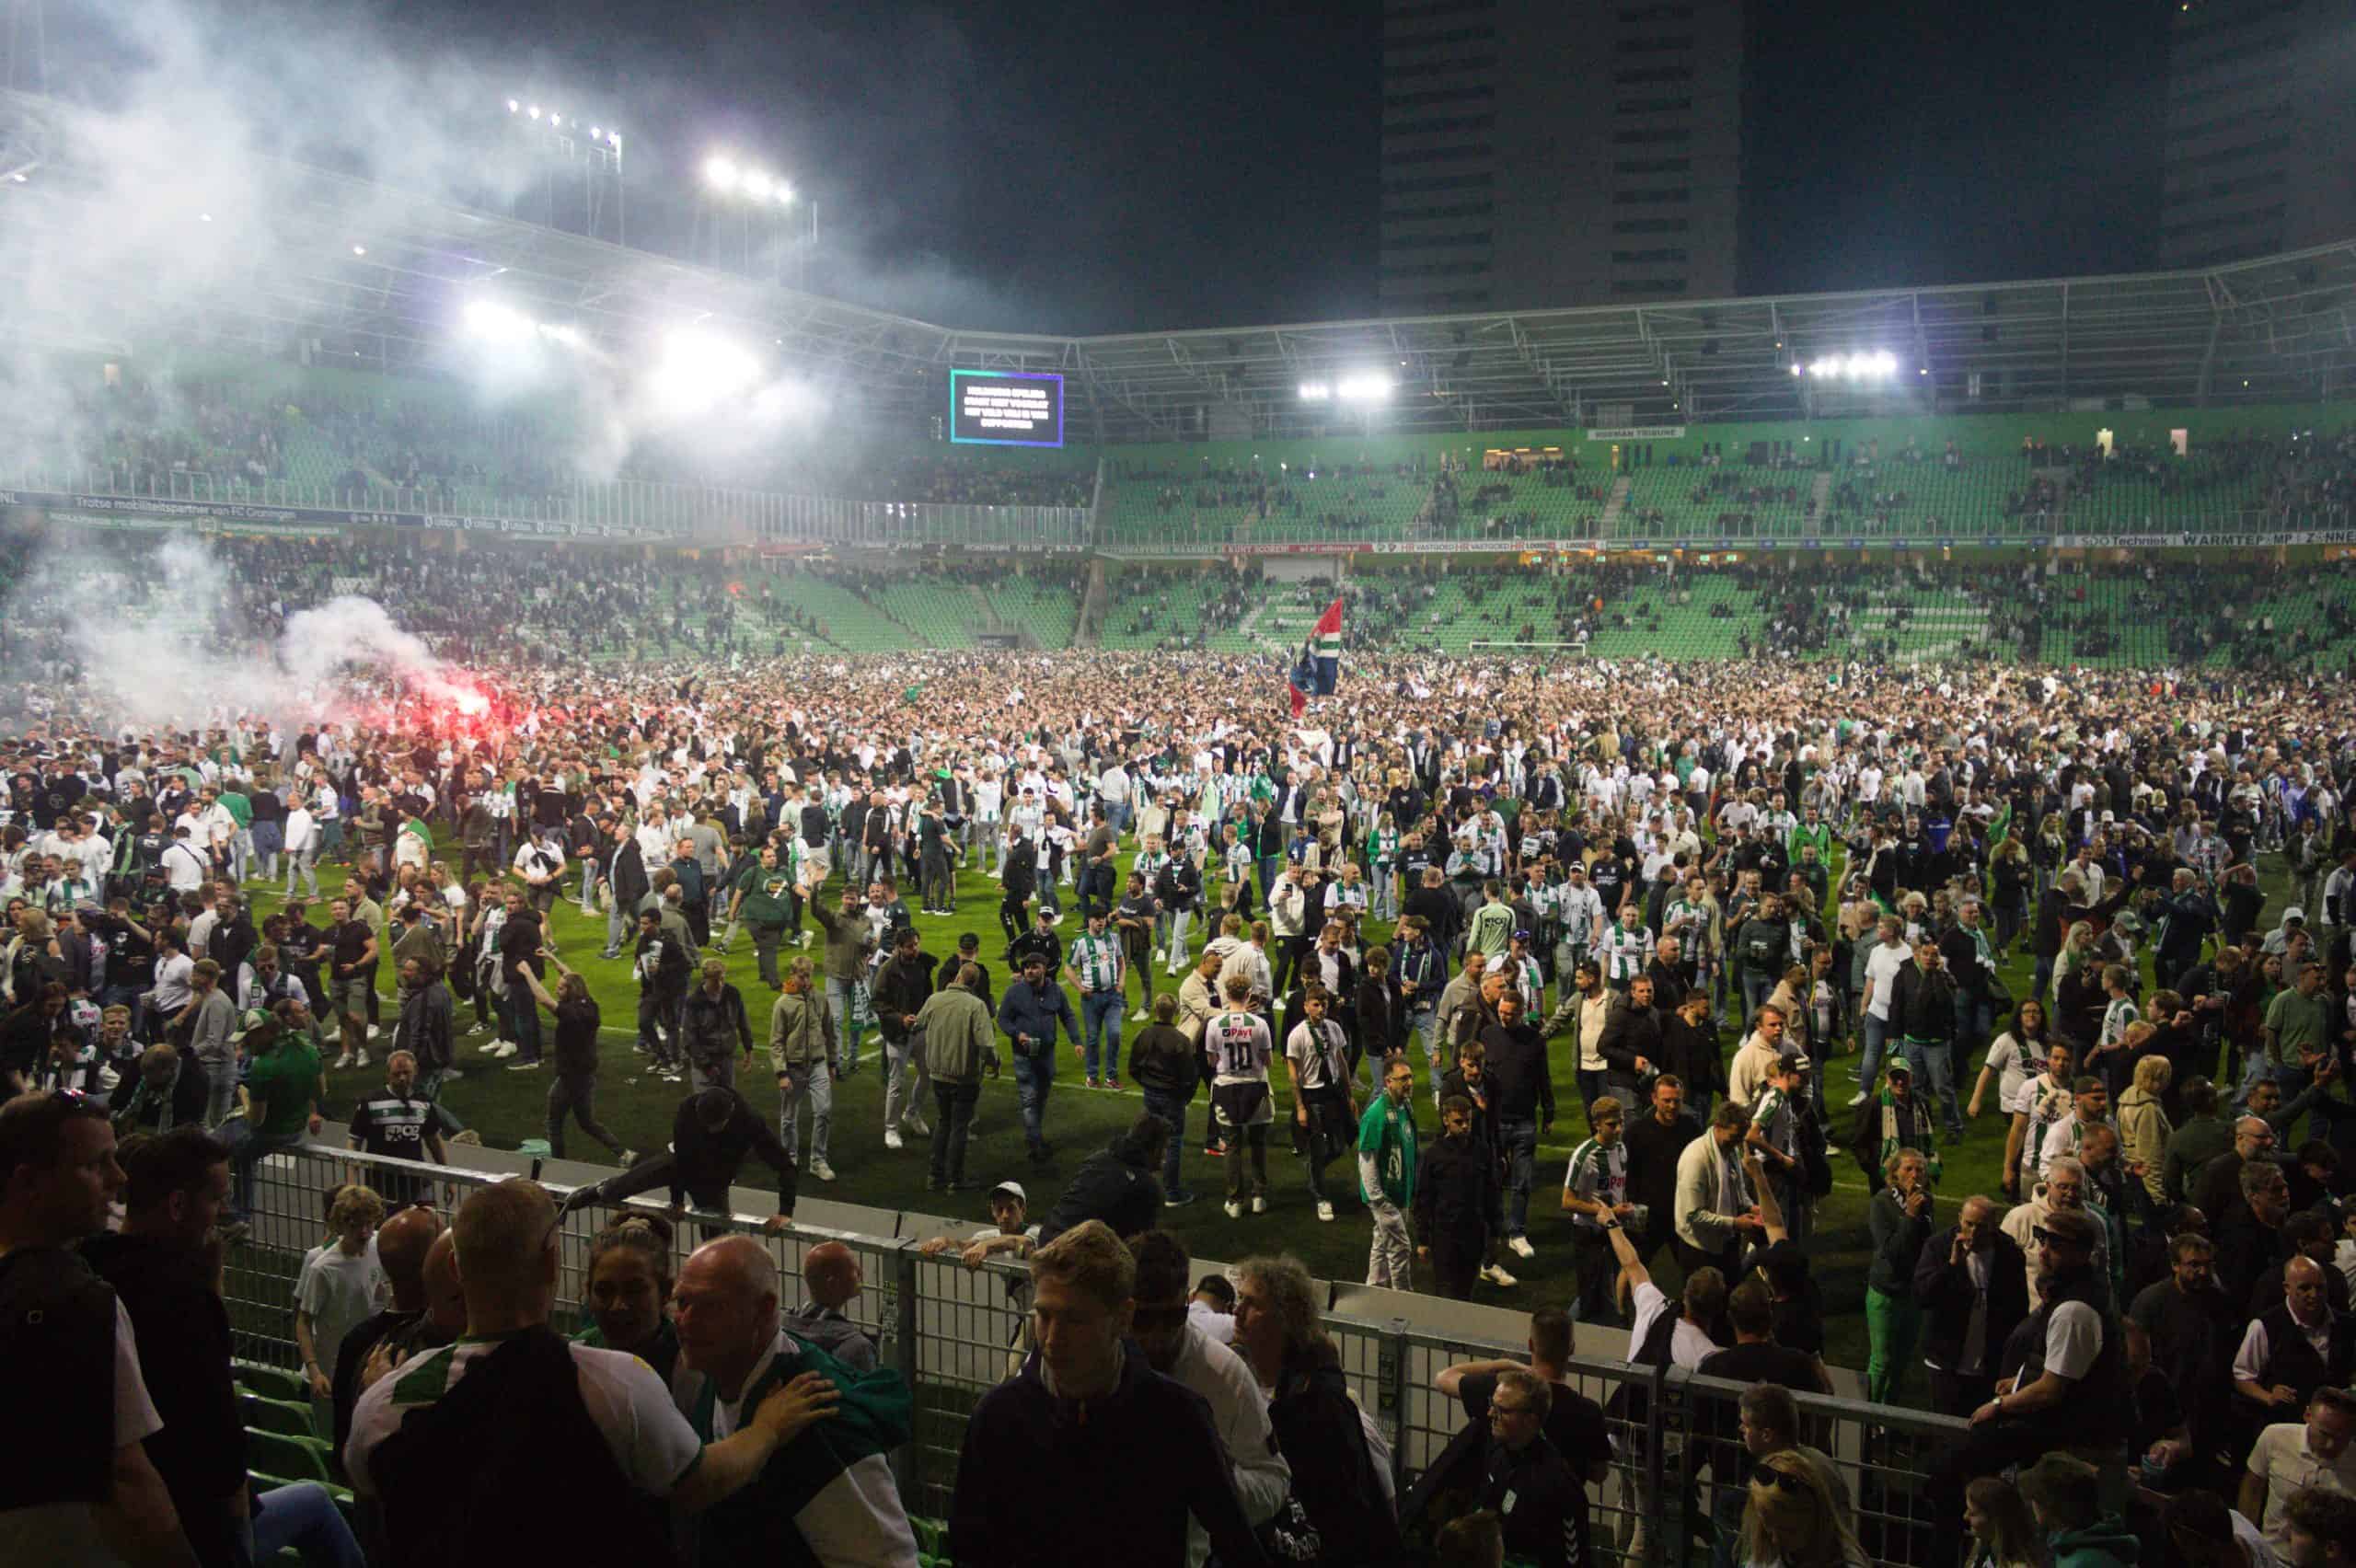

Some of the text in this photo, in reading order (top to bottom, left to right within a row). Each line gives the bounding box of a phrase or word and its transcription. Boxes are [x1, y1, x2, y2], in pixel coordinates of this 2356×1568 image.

[75, 497, 111, 509] Trotse
[2113, 536, 2167, 546] Techniek
[2183, 534, 2292, 546] WARMTEPMP
[1224, 1042, 1253, 1071] 10
